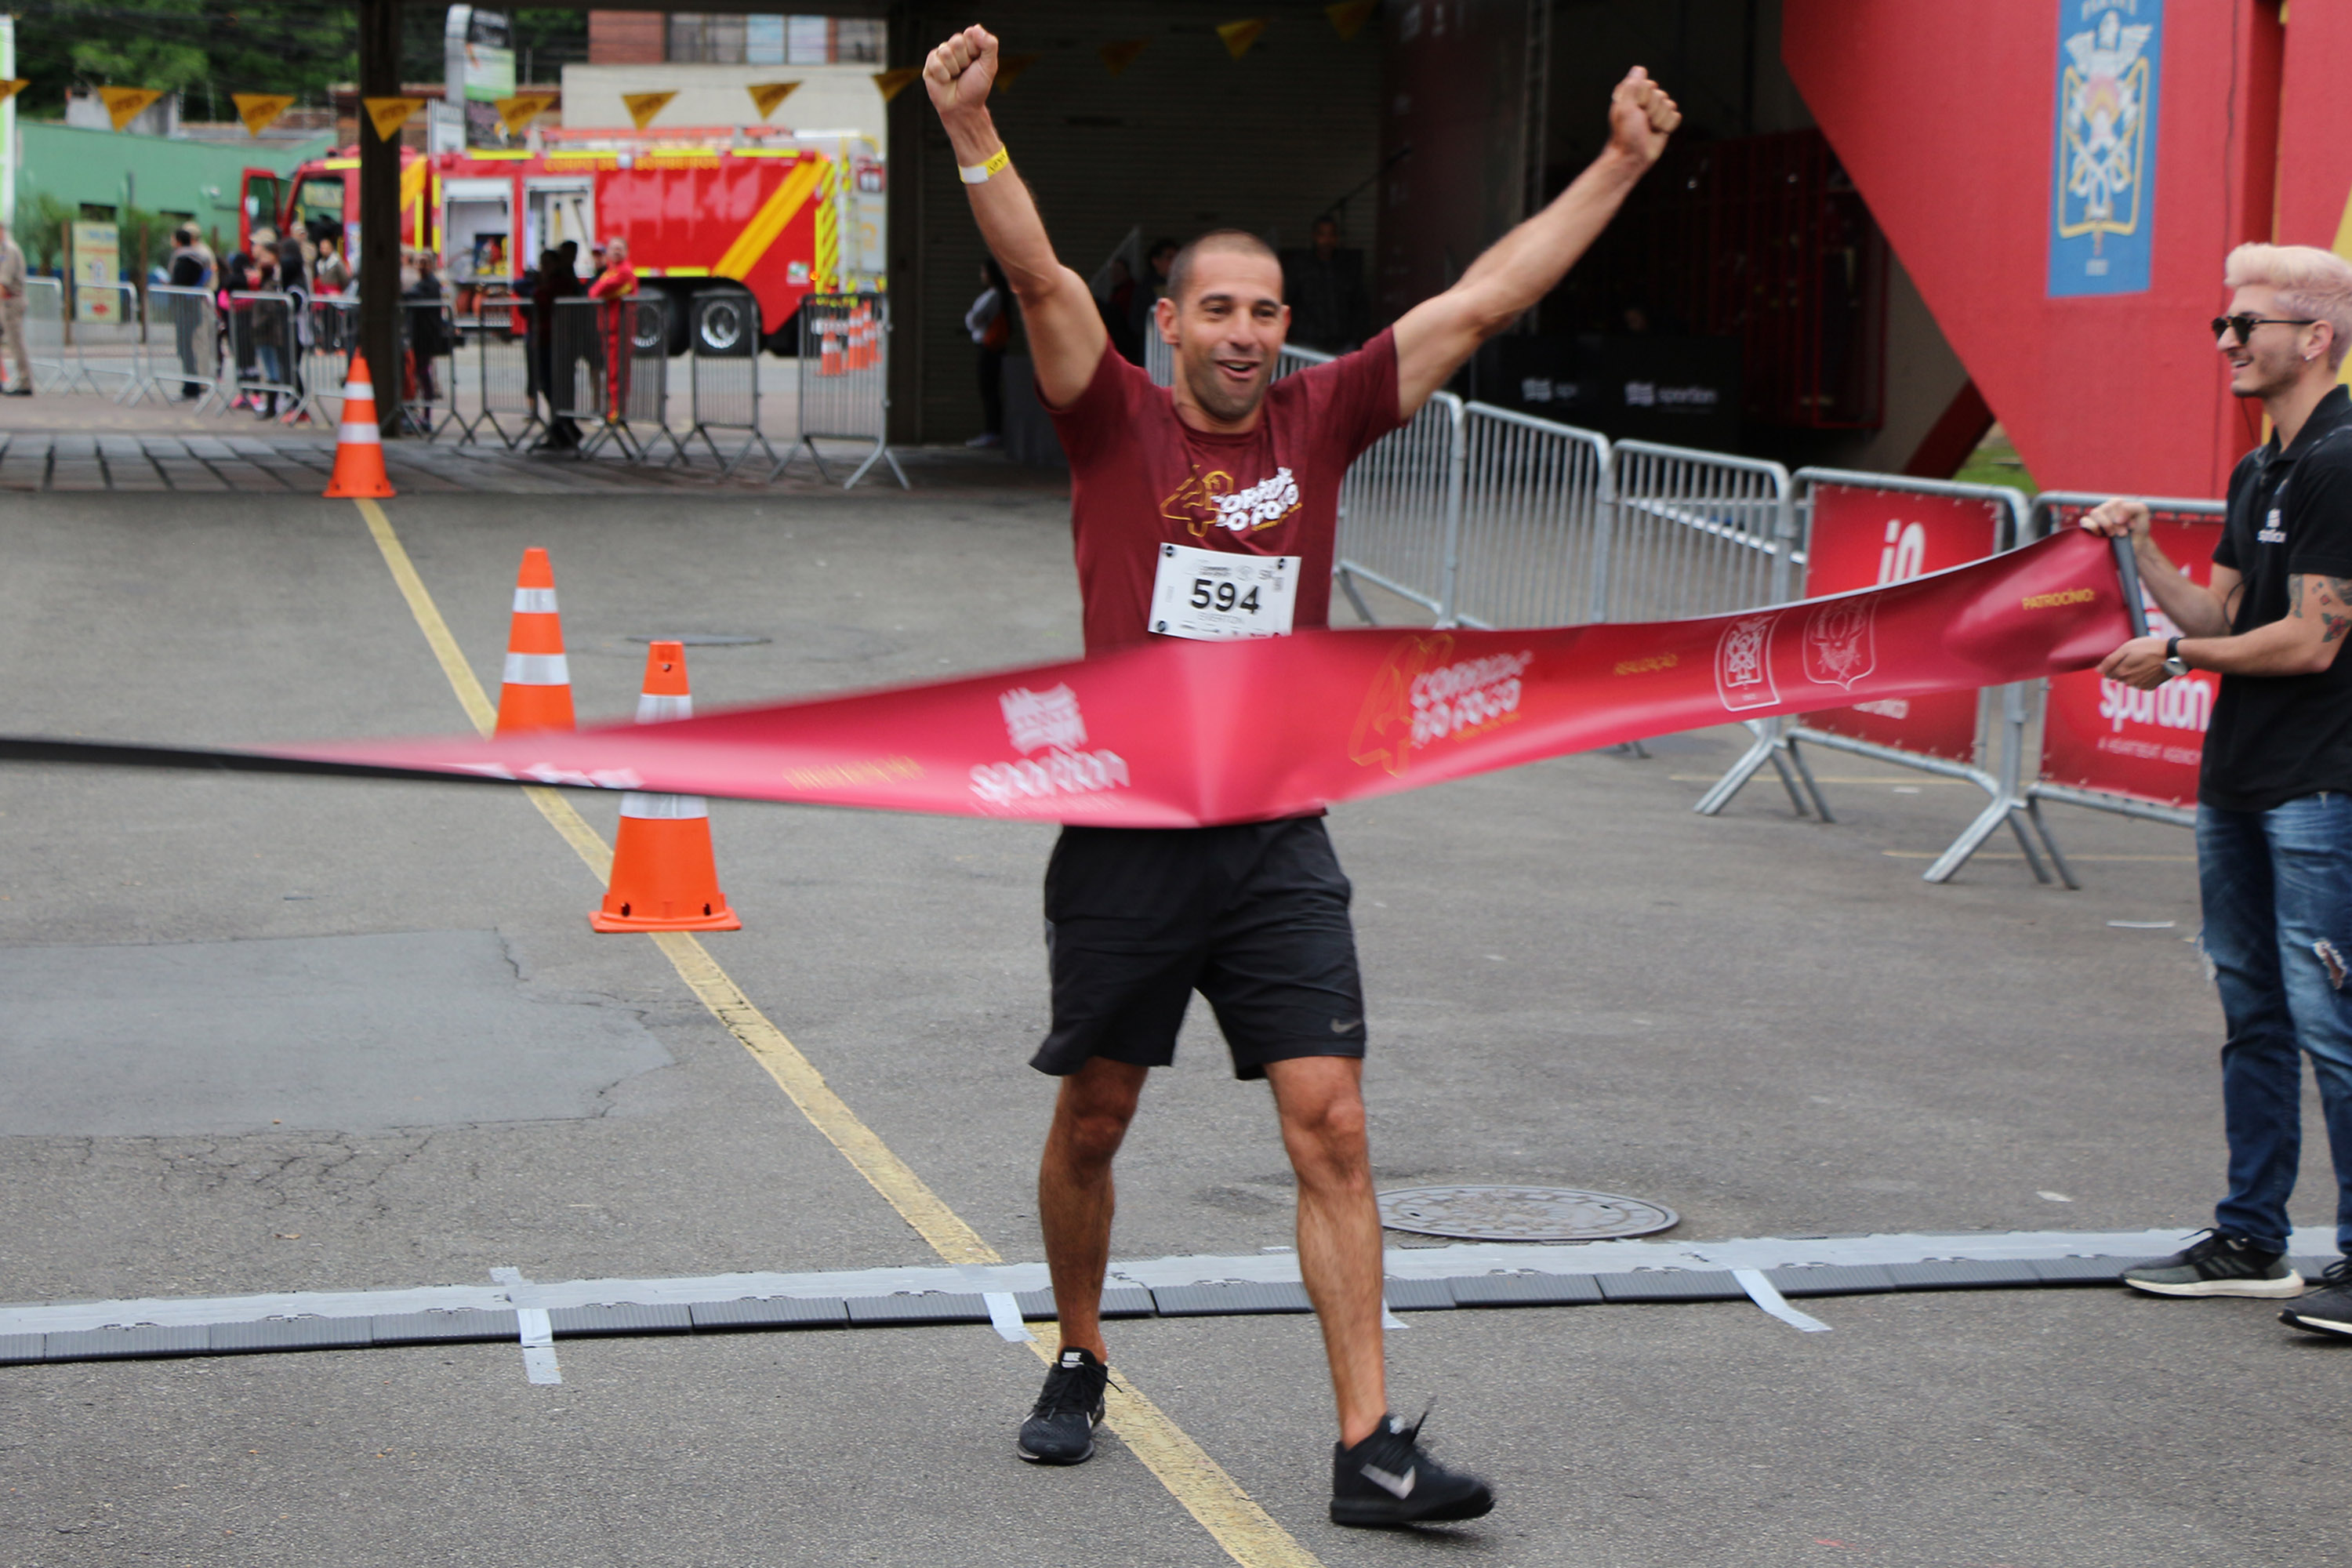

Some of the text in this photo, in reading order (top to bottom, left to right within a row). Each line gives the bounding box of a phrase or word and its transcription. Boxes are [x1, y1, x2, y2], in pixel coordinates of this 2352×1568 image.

[544, 158, 597, 172] CORPO
[634, 156, 720, 171] BOMBEIROS
[1190, 578, 1261, 615] 594
